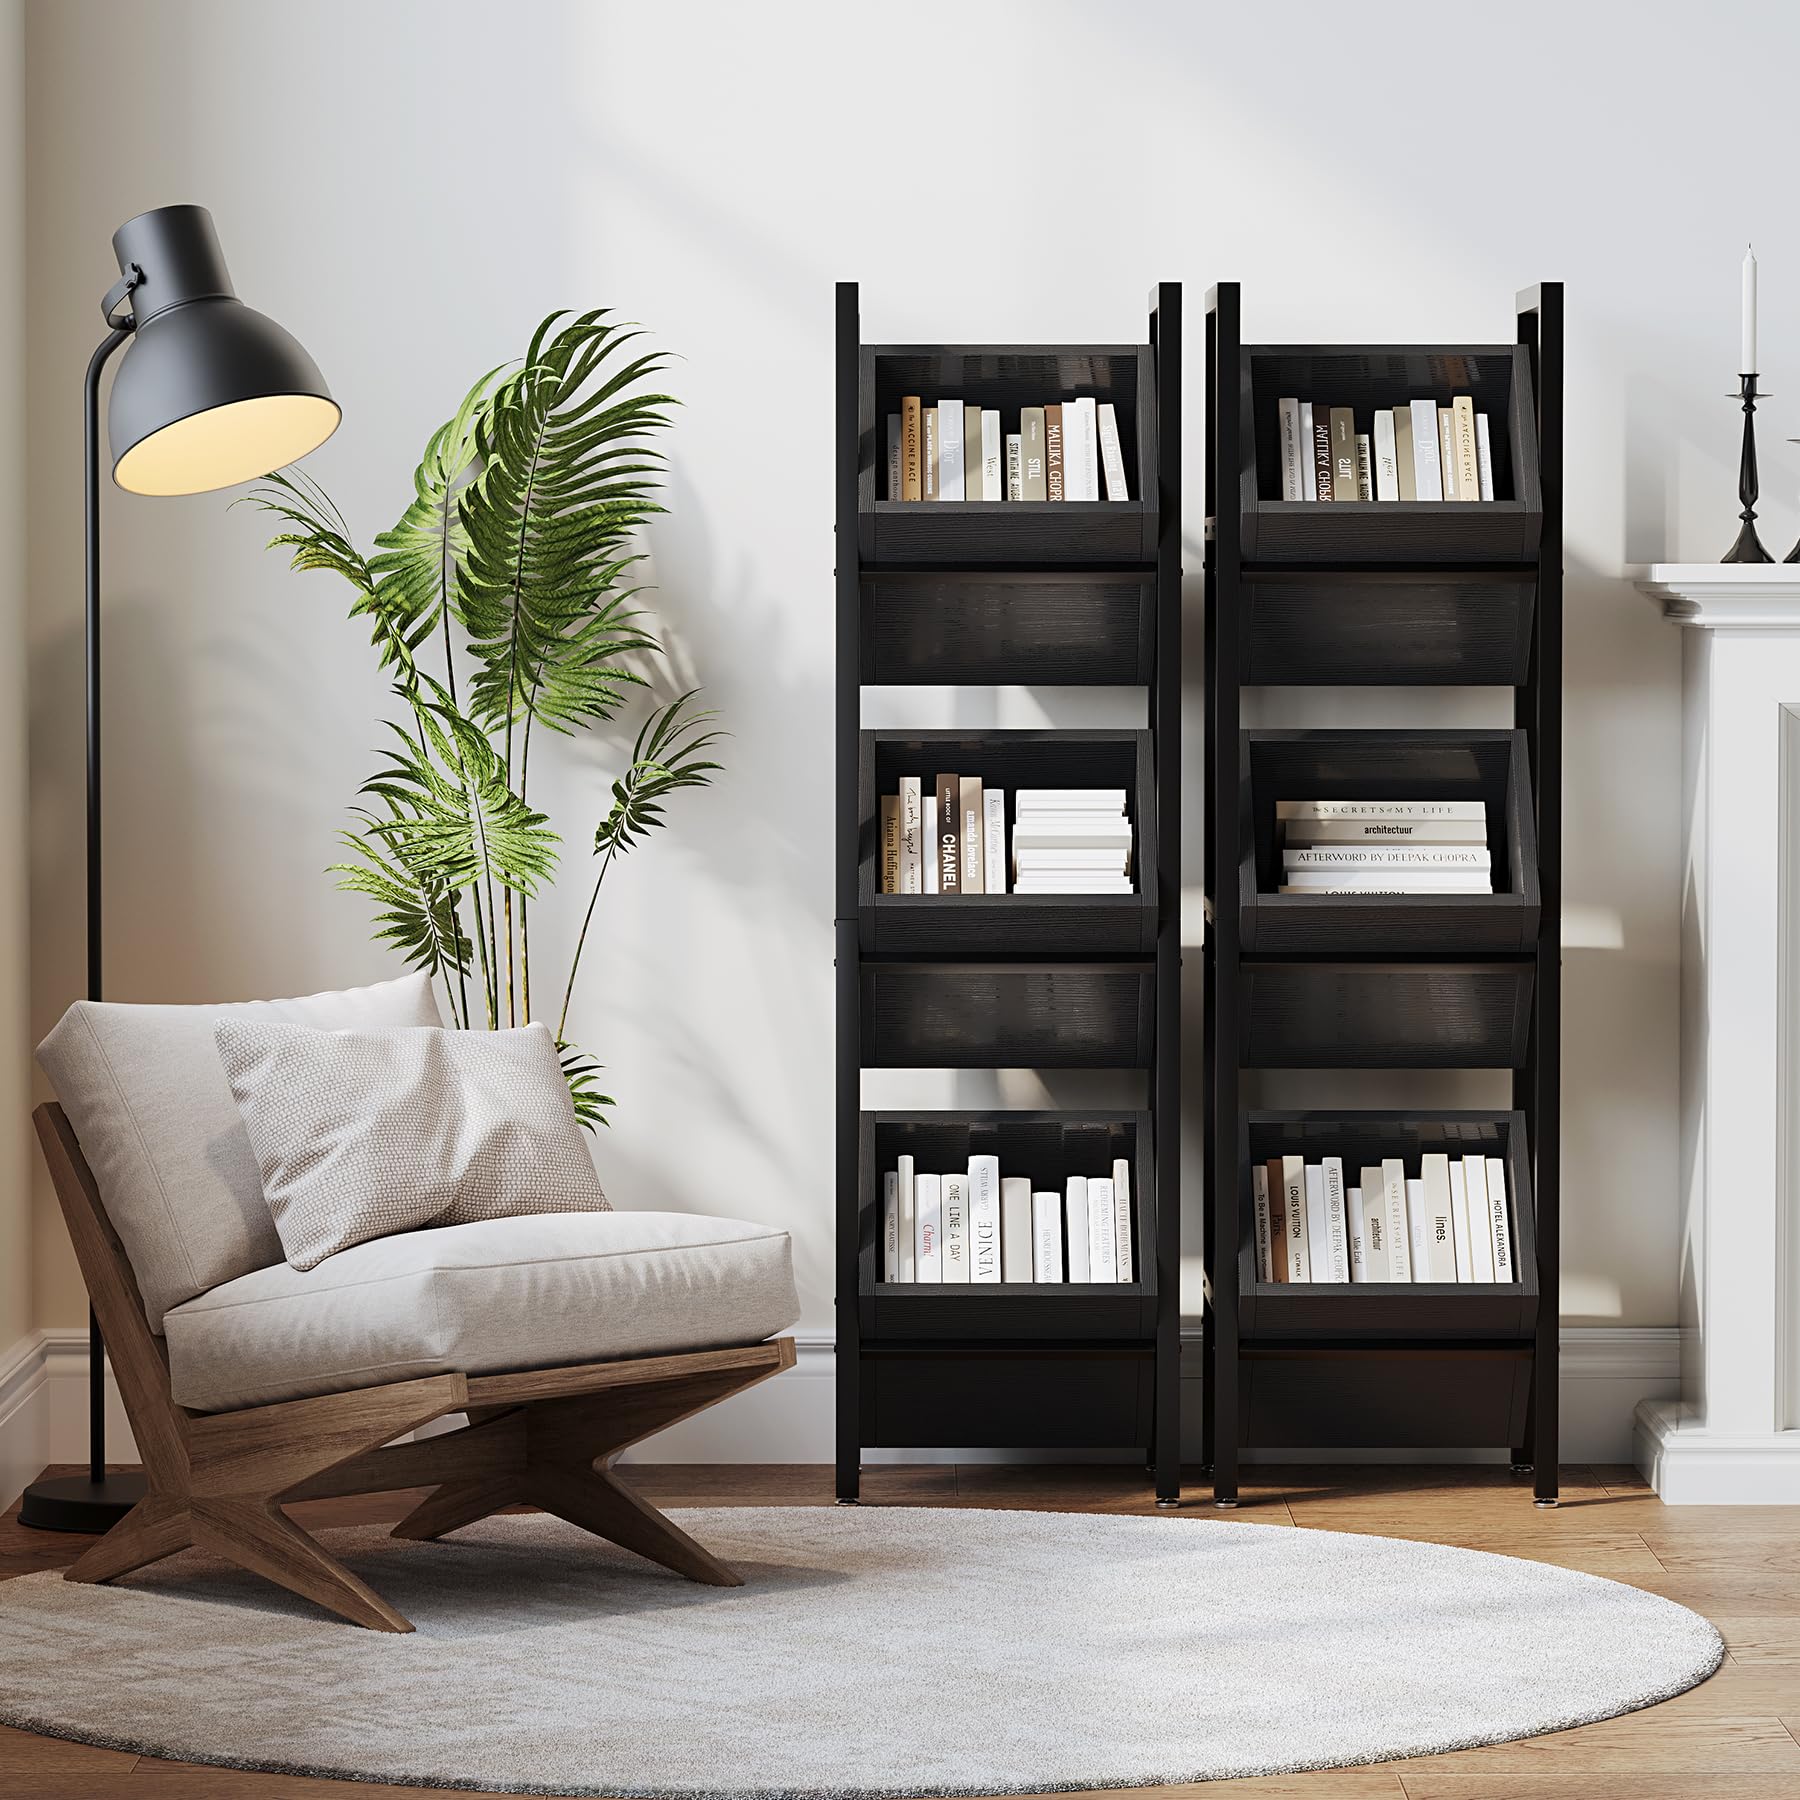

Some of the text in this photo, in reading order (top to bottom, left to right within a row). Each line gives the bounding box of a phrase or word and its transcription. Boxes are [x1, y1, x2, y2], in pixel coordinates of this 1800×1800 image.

[908, 423, 916, 458] VACCINE
[943, 440, 960, 464] Dior
[1009, 442, 1020, 455] STAY
[890, 445, 900, 468] design
[986, 456, 998, 478] West
[1048, 424, 1063, 501] MALLIKA CHOPR
[908, 461, 916, 482] RACE
[1010, 471, 1020, 480] ME
[1028, 458, 1041, 480] STILL
[902, 828, 919, 855] beyond
[1364, 825, 1414, 834] architectuur
[884, 816, 898, 894] Arianna Huffington
[966, 810, 979, 879] amanda lovelace
[942, 834, 956, 890] CHANEL
[1298, 852, 1478, 862] AFTERWORD BY DEEPAK CHOPRA
[949, 1184, 960, 1200] ONE
[979, 1168, 989, 1210] GARRY WILLS
[1328, 1166, 1340, 1212] AFTERWORD
[949, 1206, 960, 1228] LINE
[1258, 1202, 1266, 1211] Be
[1290, 1186, 1302, 1239] LOUIS VUITTON
[1392, 1190, 1402, 1230] SECRETS
[1100, 1185, 1112, 1264] REDEEMING FEATURES
[1272, 1215, 1284, 1236] Paris
[1332, 1214, 1340, 1224] BY
[1435, 1216, 1448, 1244] lines.
[923, 1224, 935, 1256] Charm!
[1332, 1225, 1343, 1254] DEEPAK
[1371, 1217, 1383, 1251] architectuur
[1395, 1236, 1402, 1250] MY
[1493, 1200, 1508, 1268] HOTEL ALEXANDRA
[950, 1244, 961, 1262] DAY
[978, 1221, 994, 1276] VENICE
[1354, 1251, 1362, 1264] End
[1396, 1255, 1404, 1278] LIFE
